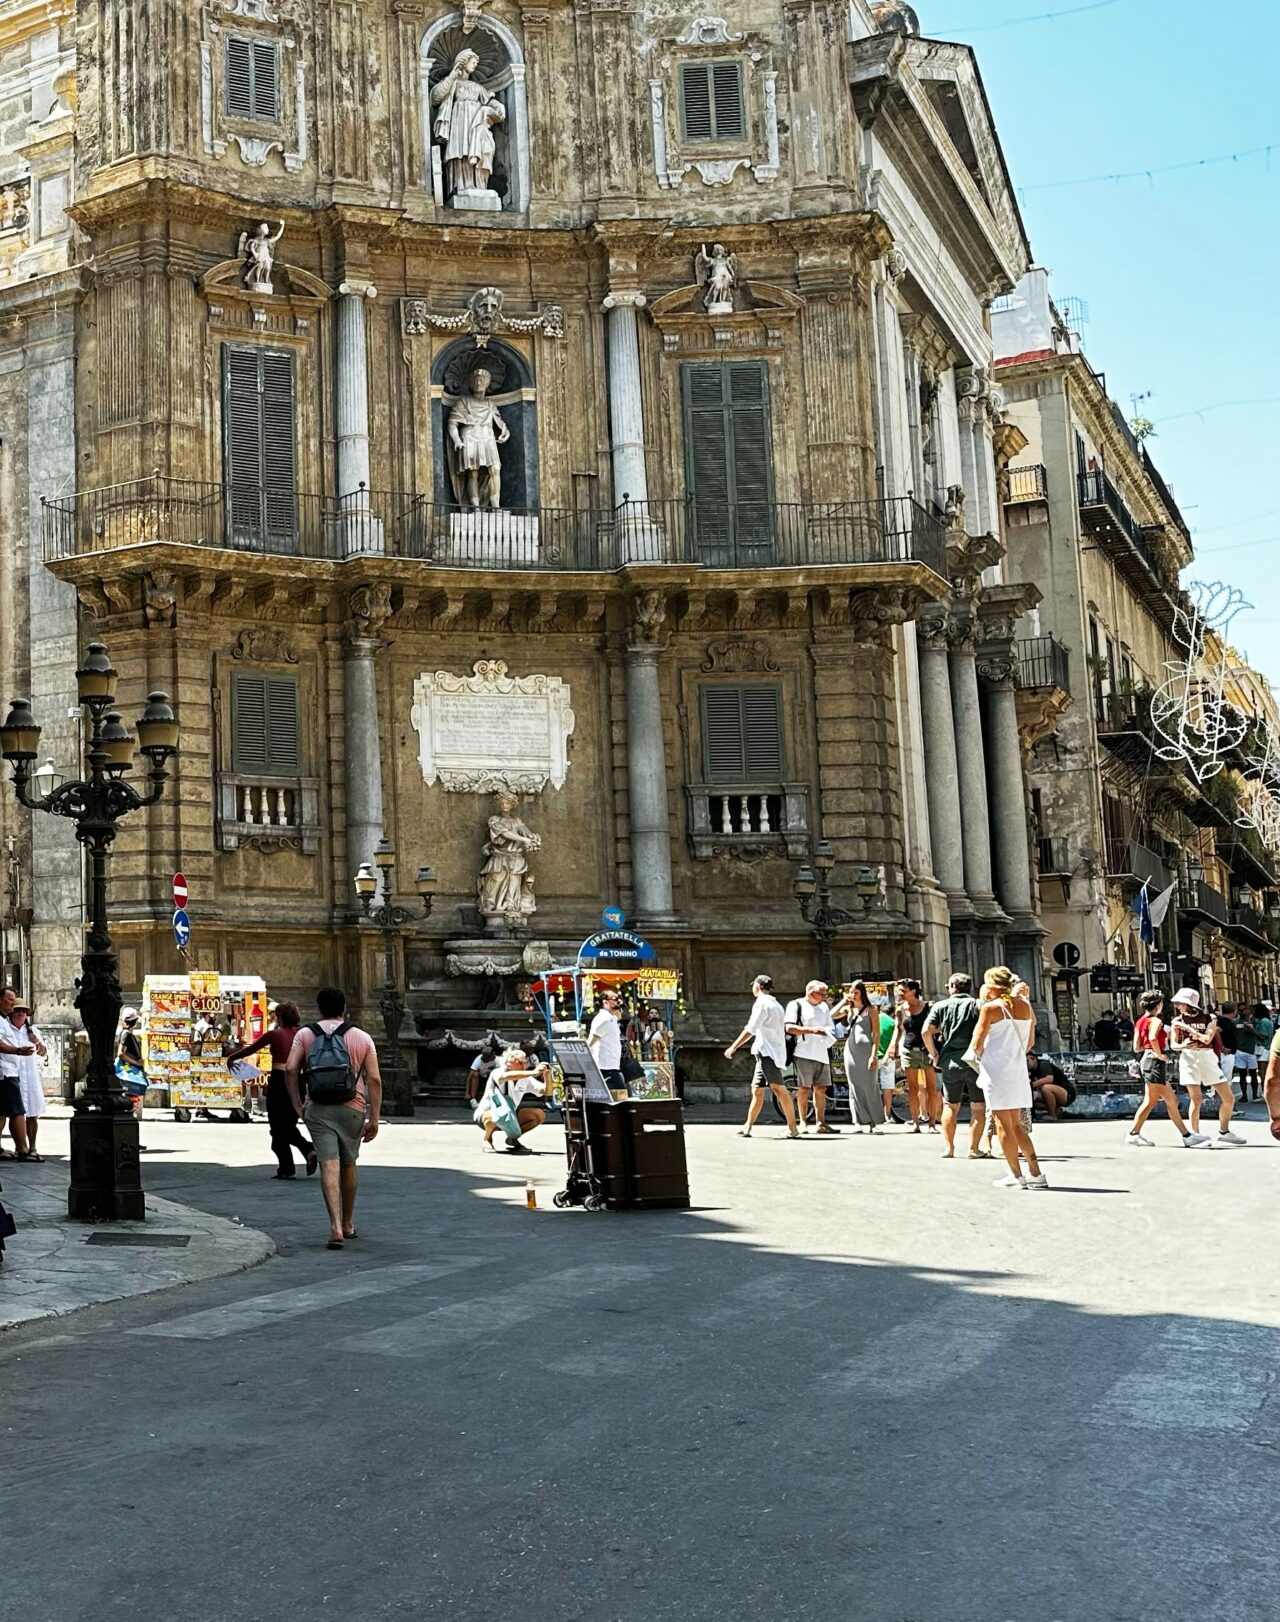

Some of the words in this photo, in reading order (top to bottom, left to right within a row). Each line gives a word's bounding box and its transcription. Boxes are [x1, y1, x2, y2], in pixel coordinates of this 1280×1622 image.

[589, 931, 645, 949] GRATTATELLA
[609, 950, 638, 958] TONINO
[640, 969, 677, 978] GRATTATELLA
[640, 982, 652, 997] 1€
